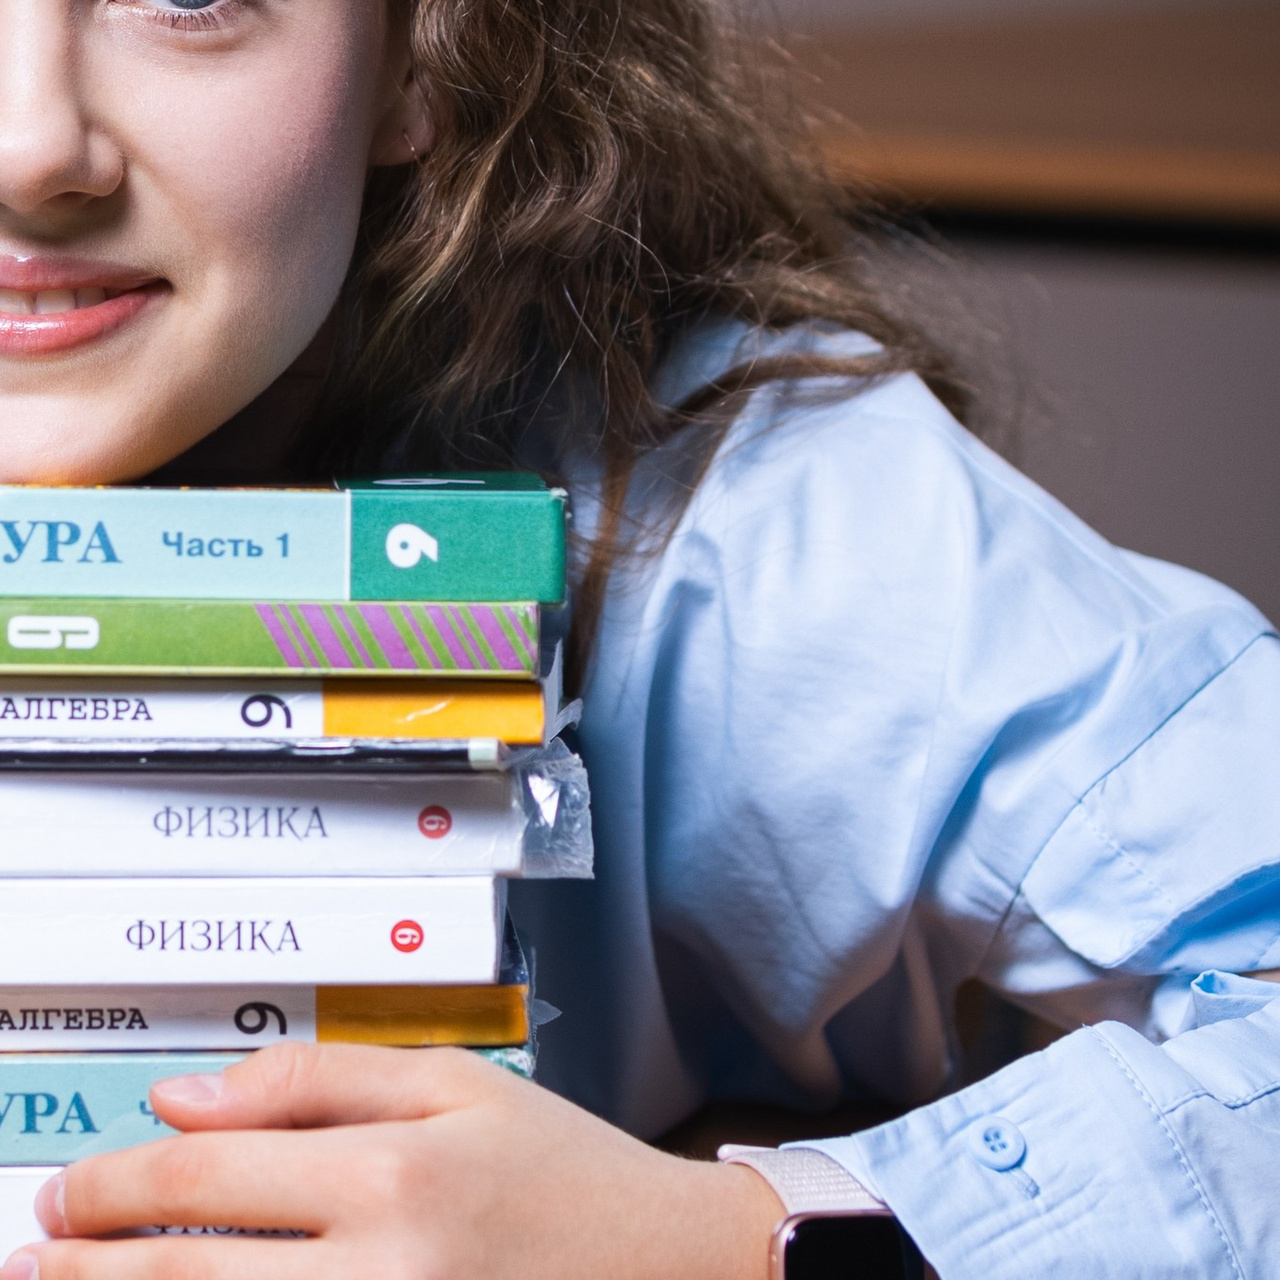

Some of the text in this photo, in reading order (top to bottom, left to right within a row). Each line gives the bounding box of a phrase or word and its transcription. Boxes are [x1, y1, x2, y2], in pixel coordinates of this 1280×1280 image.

[161, 531, 264, 558] Часть
[276, 532, 290, 558] 1
[0, 696, 154, 721] АЛГЕБРА
[152, 805, 330, 841] ФИЗИКА
[125, 919, 302, 954] ФИЗИКА
